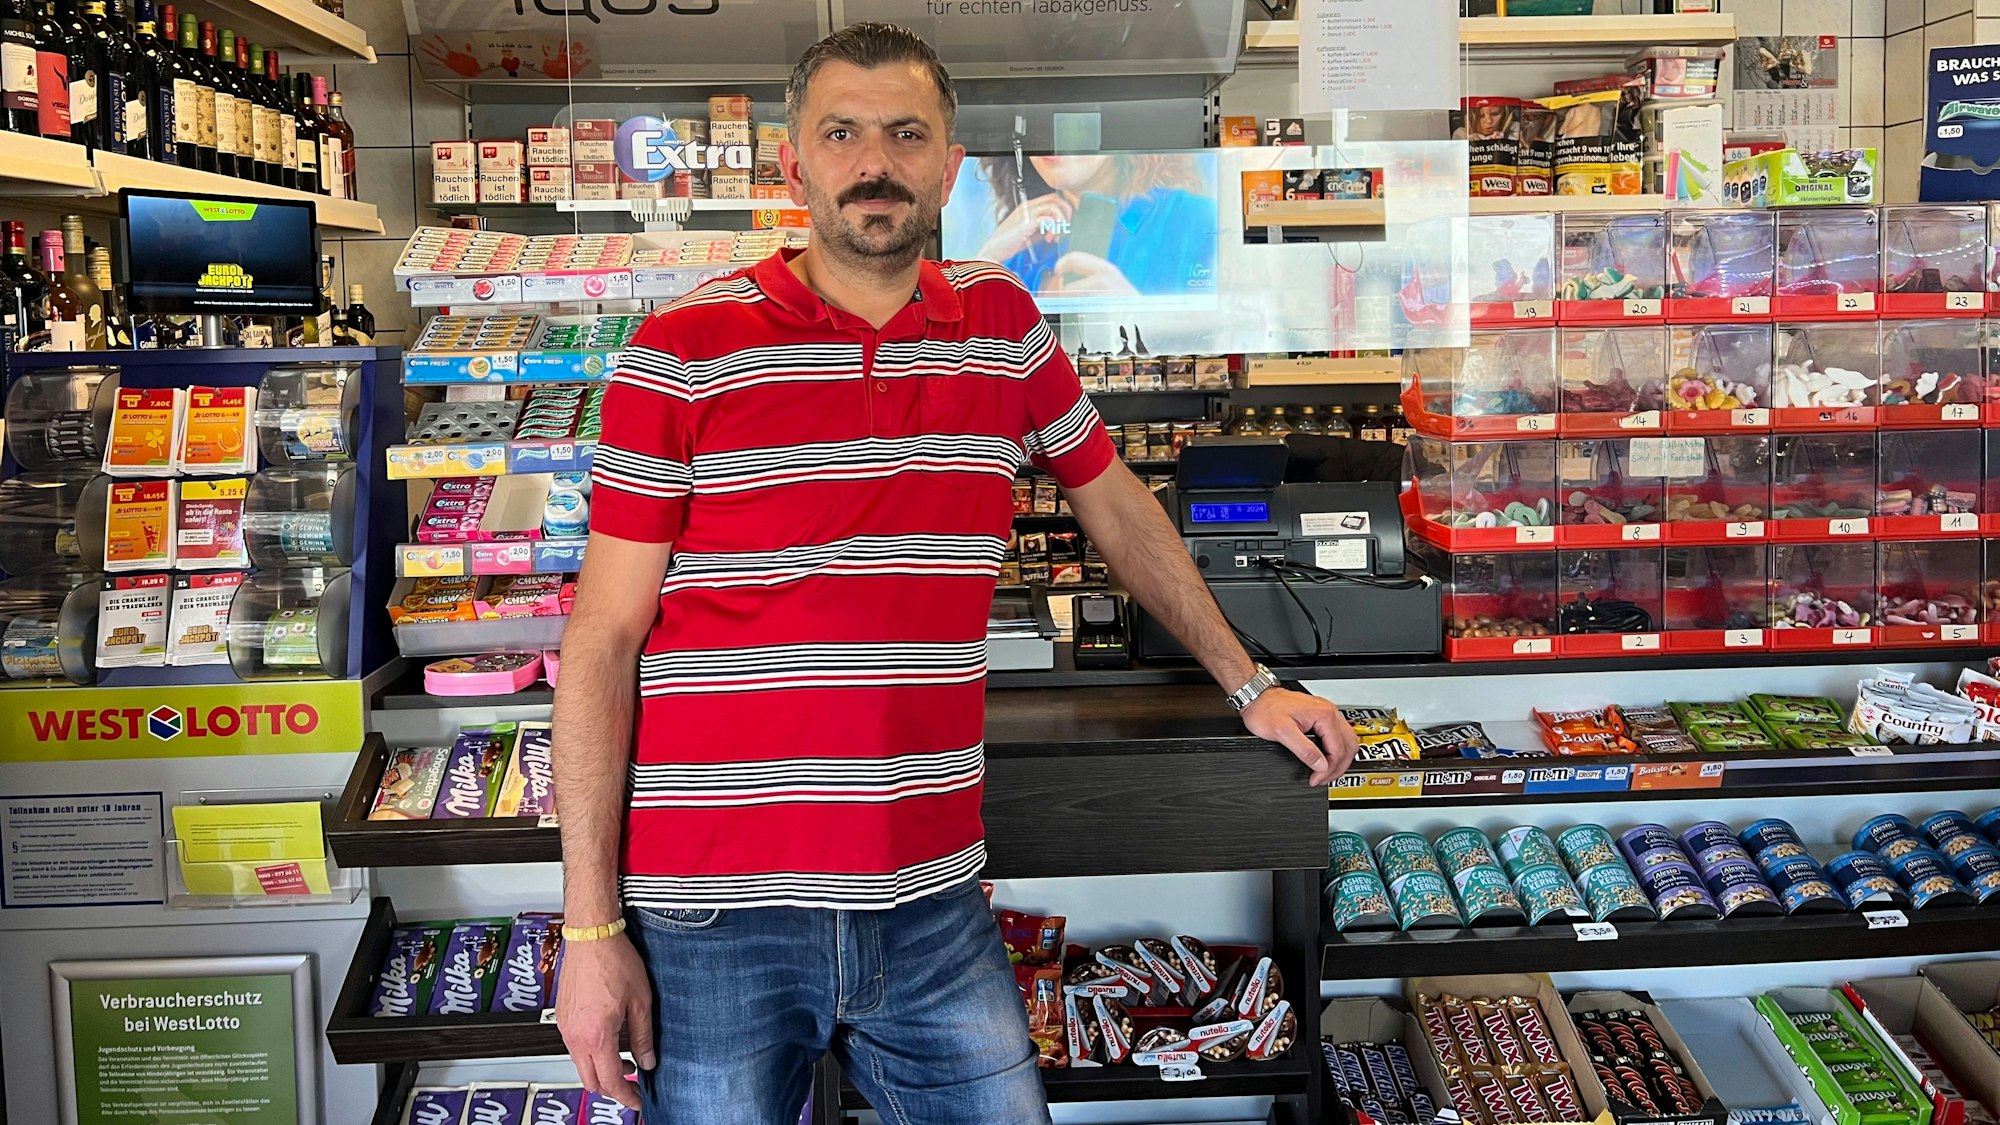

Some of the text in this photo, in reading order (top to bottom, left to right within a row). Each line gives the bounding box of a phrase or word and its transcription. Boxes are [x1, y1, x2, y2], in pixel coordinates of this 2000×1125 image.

[927, 0, 1153, 16] für echten Tabakgenuss.
[1953, 71, 1989, 86] WAS
[711, 122, 748, 130] Rauchen
[724, 131, 735, 139] ist
[631, 130, 753, 170] Extra
[1486, 143, 1518, 154] schädigt
[1582, 146, 1602, 154] 9 von
[541, 155, 569, 163] tödlich
[435, 175, 474, 183] Rauchen
[480, 174, 519, 183] Rauchen
[713, 176, 749, 185] Rauchen
[1484, 178, 1511, 189] West
[725, 185, 736, 193] ist
[1795, 184, 1833, 192] ORIGINAL
[439, 194, 470, 202] tödlich
[485, 193, 515, 201] tödlich
[532, 194, 540, 202] ist
[203, 206, 246, 215] WEST LOTTO
[1040, 220, 1071, 235] Mit
[207, 263, 239, 275] EURO
[1845, 299, 1857, 308] 22
[1955, 296, 1968, 307] 23
[1524, 307, 1537, 318] 19
[1632, 304, 1648, 315] 20
[1740, 302, 1751, 313] 21
[202, 411, 220, 419] LOTTO
[1845, 412, 1857, 421] 16
[1950, 407, 1963, 418] 17
[1632, 415, 1647, 426] 14
[1742, 413, 1755, 424] 15
[1527, 419, 1539, 431] 13
[239, 487, 244, 495] €
[442, 482, 472, 490] extra
[435, 500, 465, 508] extra
[123, 506, 143, 514] LOTTO
[214, 508, 233, 516] Rente
[185, 515, 207, 524] sofort!
[428, 516, 458, 525] extra
[1950, 517, 1962, 527] 11
[1632, 526, 1641, 540] 8
[1736, 523, 1748, 535] 9
[1838, 523, 1850, 533] 10
[1527, 530, 1536, 540] 7
[177, 580, 188, 588] XL
[440, 575, 471, 584] CHEW
[517, 575, 552, 585] CHEW
[106, 581, 111, 589] L
[427, 595, 460, 605] CHEW
[505, 595, 541, 605] CHEW
[122, 602, 163, 610] TRAUMLEBEN
[1844, 631, 1853, 641] 4
[1952, 627, 1966, 638] 5
[1635, 636, 1644, 647] 2
[1739, 634, 1748, 644] 3
[1527, 641, 1533, 653] 1
[1878, 682, 1910, 691] Country
[1552, 708, 1604, 723] Balisto
[27, 703, 319, 742] WEST LOTTO
[1881, 713, 1944, 736] Country
[424, 748, 449, 797] Schogetten
[1577, 770, 1598, 779] CRISPY
[1638, 766, 1668, 776] Balisto
[446, 752, 483, 816] Milka
[1371, 777, 1392, 785] PEANUT
[9, 806, 50, 815] Teilnahme
[53, 805, 74, 813] nicht
[102, 804, 111, 812] 18
[114, 804, 141, 812] Jahren
[1560, 829, 1599, 849] CASHEW-
[1444, 840, 1472, 854] KERNE
[1566, 837, 1593, 852] KERNE
[1969, 853, 1991, 863] Alesto
[1786, 863, 1809, 871] Alesto
[1907, 858, 1929, 869] Alesto
[1655, 868, 1679, 878] Alesto
[1721, 865, 1747, 874] Alesto
[1337, 877, 1375, 891] CASHEW-
[1406, 876, 1444, 887] CASHEW-
[1522, 871, 1560, 887] CASHEW-
[1599, 876, 1628, 886] KERNE
[1413, 883, 1443, 892] KERNE
[1529, 878, 1559, 891] KERNE
[1343, 885, 1373, 895] KERNE
[1577, 927, 1589, 937] €
[503, 941, 541, 1012] Milka
[374, 954, 413, 1017] Milka
[440, 949, 478, 1015] Milka
[1246, 978, 1261, 1006] nutella
[100, 991, 263, 1010] Verbraucherschutz
[124, 1015, 240, 1032] bei WestLotto
[1101, 1018, 1116, 1048] nutella
[1200, 1025, 1229, 1037] nutella
[1256, 1017, 1275, 1043] nutella
[1425, 1007, 1456, 1062] Twix
[1450, 1008, 1487, 1065] Twix
[1484, 1008, 1524, 1065] Twix
[1517, 1008, 1559, 1063] Twix
[98, 1045, 142, 1054] Jugendschutz
[156, 1044, 195, 1053] Vorbeugung
[1157, 1053, 1187, 1062] nutella
[1174, 1067, 1197, 1078] 2,00
